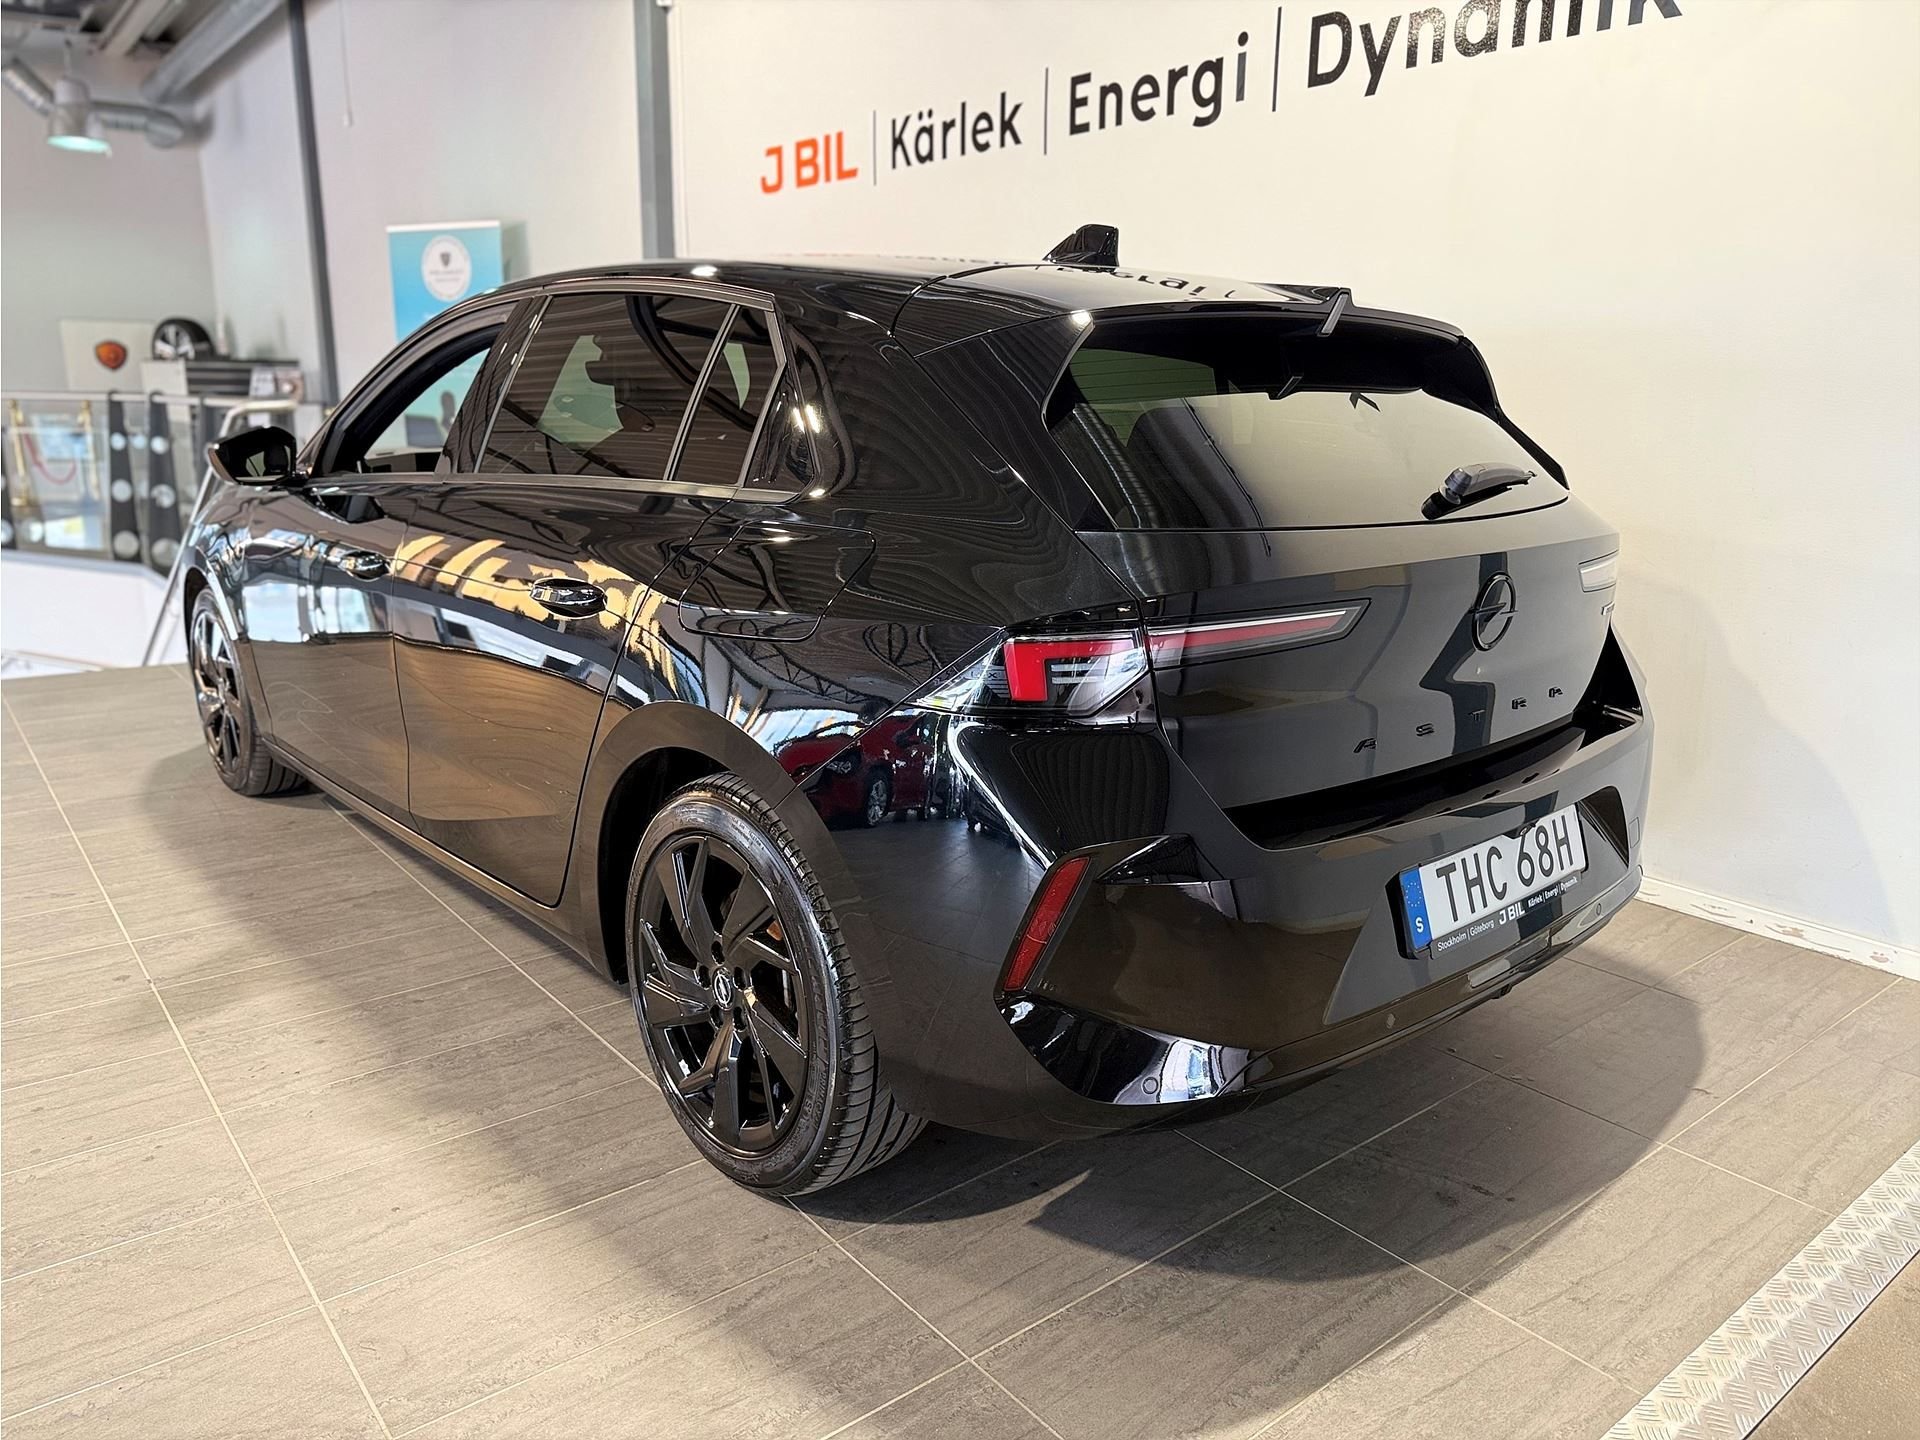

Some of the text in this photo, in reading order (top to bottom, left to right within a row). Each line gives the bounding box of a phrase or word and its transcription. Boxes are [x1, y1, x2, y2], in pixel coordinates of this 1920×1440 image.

[891, 91, 1023, 170] Kärlek
[1069, 31, 1249, 136] Energi
[1307, 0, 1683, 97] Dynam
[1436, 815, 1575, 922] THC 68H
[1415, 917, 1425, 933] S
[1437, 932, 1467, 951] Stockholm
[1470, 919, 1495, 936] Göteborg
